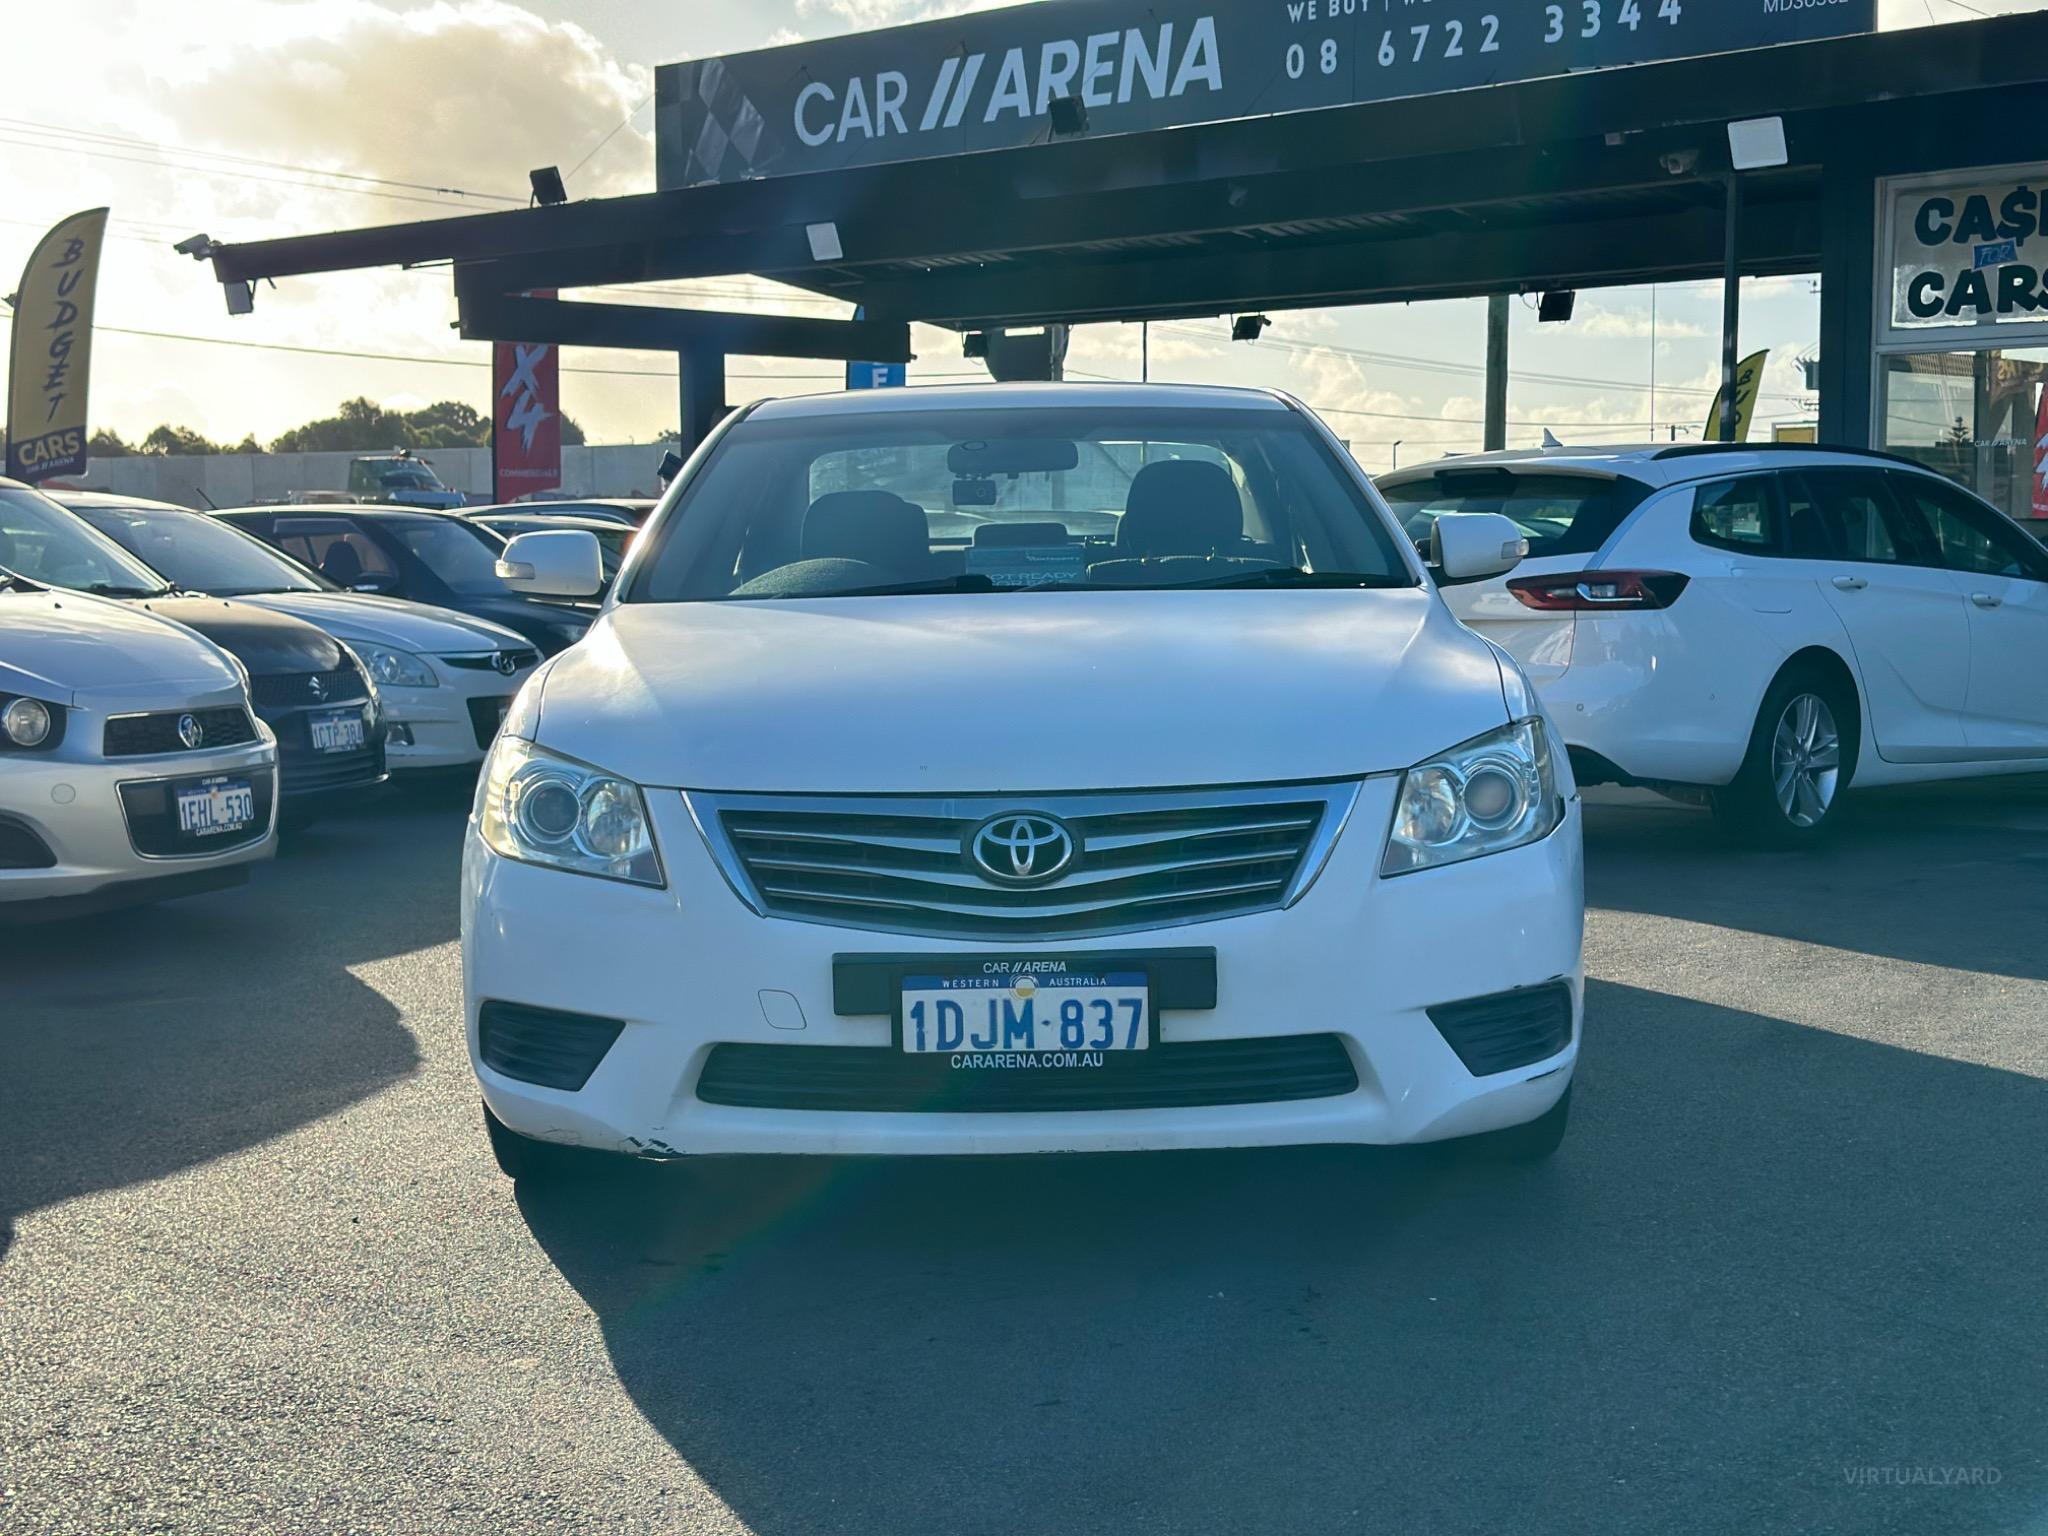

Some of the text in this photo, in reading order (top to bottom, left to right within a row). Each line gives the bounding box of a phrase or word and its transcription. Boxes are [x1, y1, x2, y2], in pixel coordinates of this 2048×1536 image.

[1286, 0, 1682, 80] 08 6722 3344
[794, 70, 909, 147] CAR
[983, 15, 1224, 124] ARENA
[1914, 185, 2048, 247] CA$
[43, 236, 84, 423] BUDGET
[18, 431, 81, 466] CARS
[942, 977, 1107, 988] WESTERN AUSTRALIA
[983, 962, 1010, 974] CAR
[1022, 961, 1067, 973] ARENA
[951, 1053, 1104, 1069] CARARENA.COM.AU
